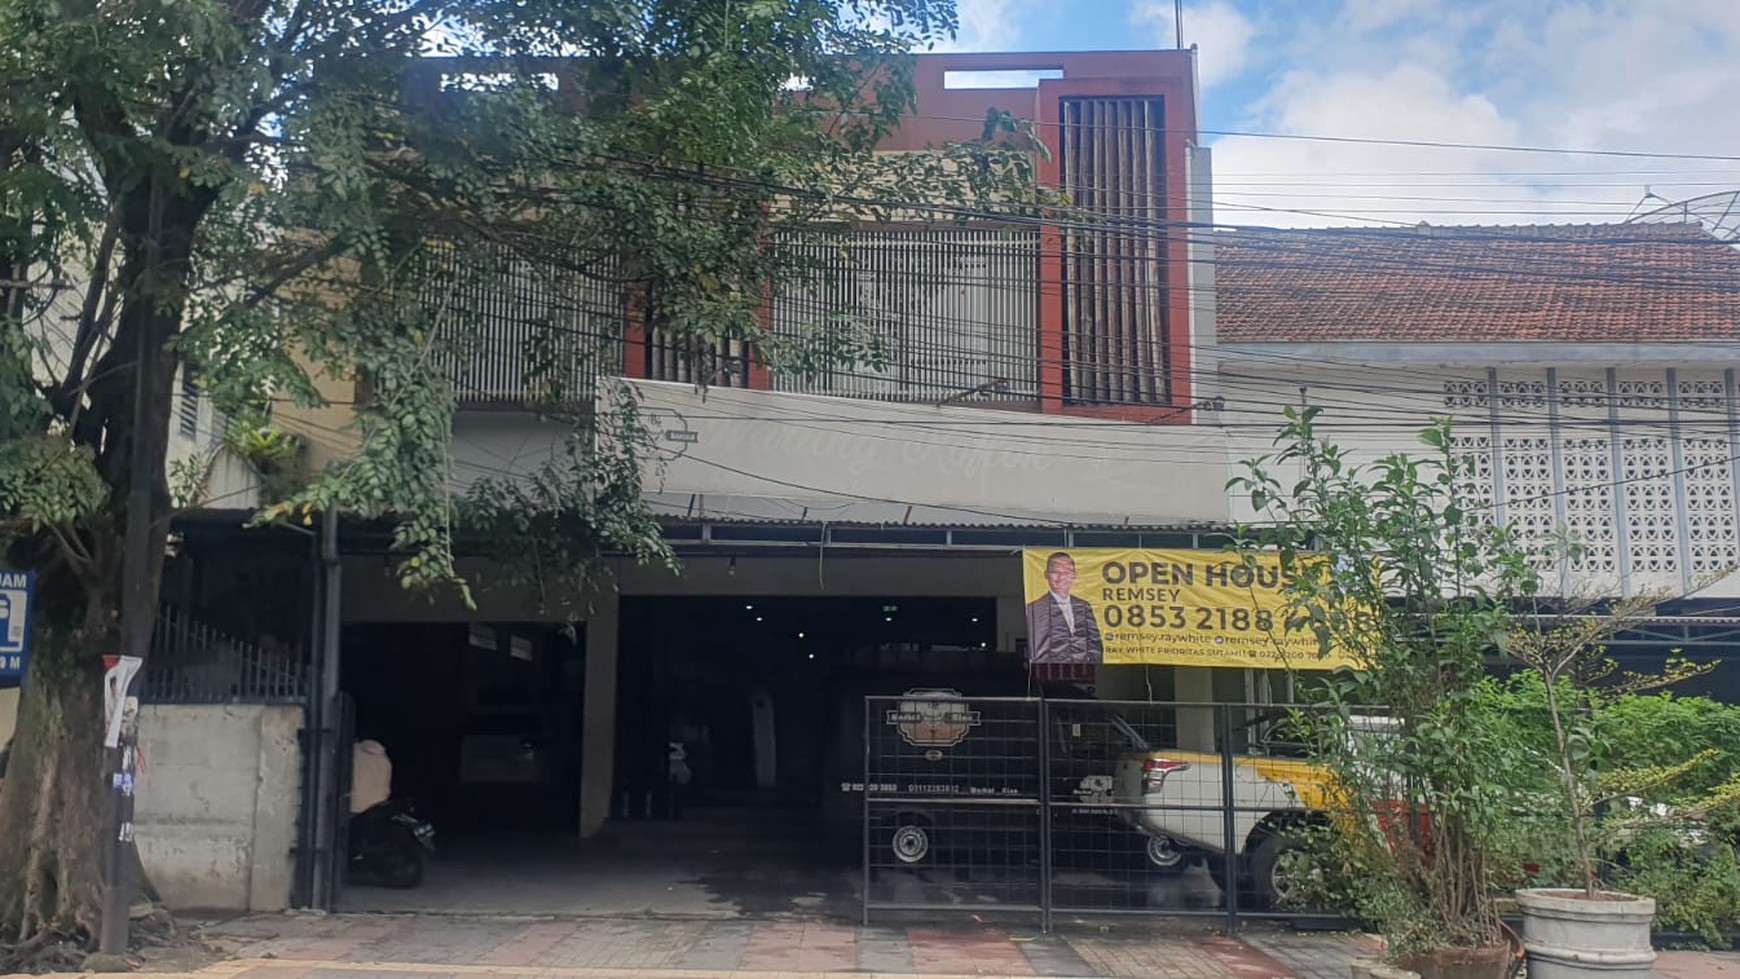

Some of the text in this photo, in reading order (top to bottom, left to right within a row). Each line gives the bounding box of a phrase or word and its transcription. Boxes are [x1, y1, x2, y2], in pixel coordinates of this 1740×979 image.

[1102, 561, 1299, 589] OPEN HOUS
[1103, 588, 1180, 602] REMSEY
[1104, 604, 1186, 628] 0853
[1195, 607, 1273, 631] 2188
[9, 656, 20, 670] M
